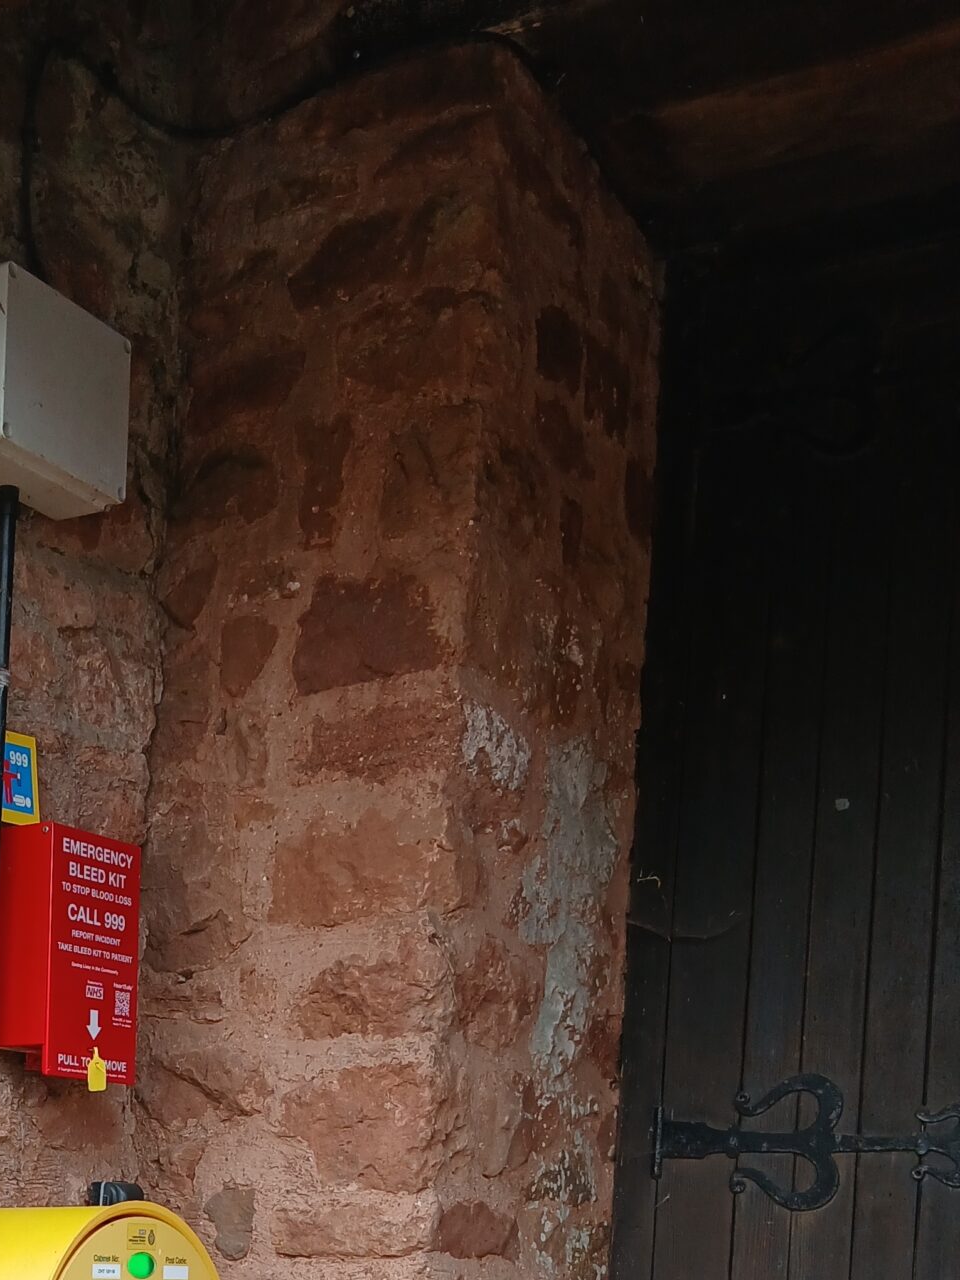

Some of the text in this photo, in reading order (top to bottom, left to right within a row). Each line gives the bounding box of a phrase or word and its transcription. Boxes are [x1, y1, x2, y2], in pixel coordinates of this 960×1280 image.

[9, 750, 28, 768] 999
[62, 837, 133, 869] EMERGENCY
[69, 861, 126, 889] BLEED KIT
[62, 881, 132, 906] TO STOP BLOOD LOSS
[68, 903, 126, 932] CALL 999
[71, 929, 121, 946] REPORT INCIDENT
[57, 941, 133, 964] TAKE BLEED KIT TO PATIENT
[86, 986, 102, 998] NHS
[58, 1053, 79, 1066] PULL
[104, 1060, 127, 1073] MOVE
[165, 1256, 174, 1264] Post
